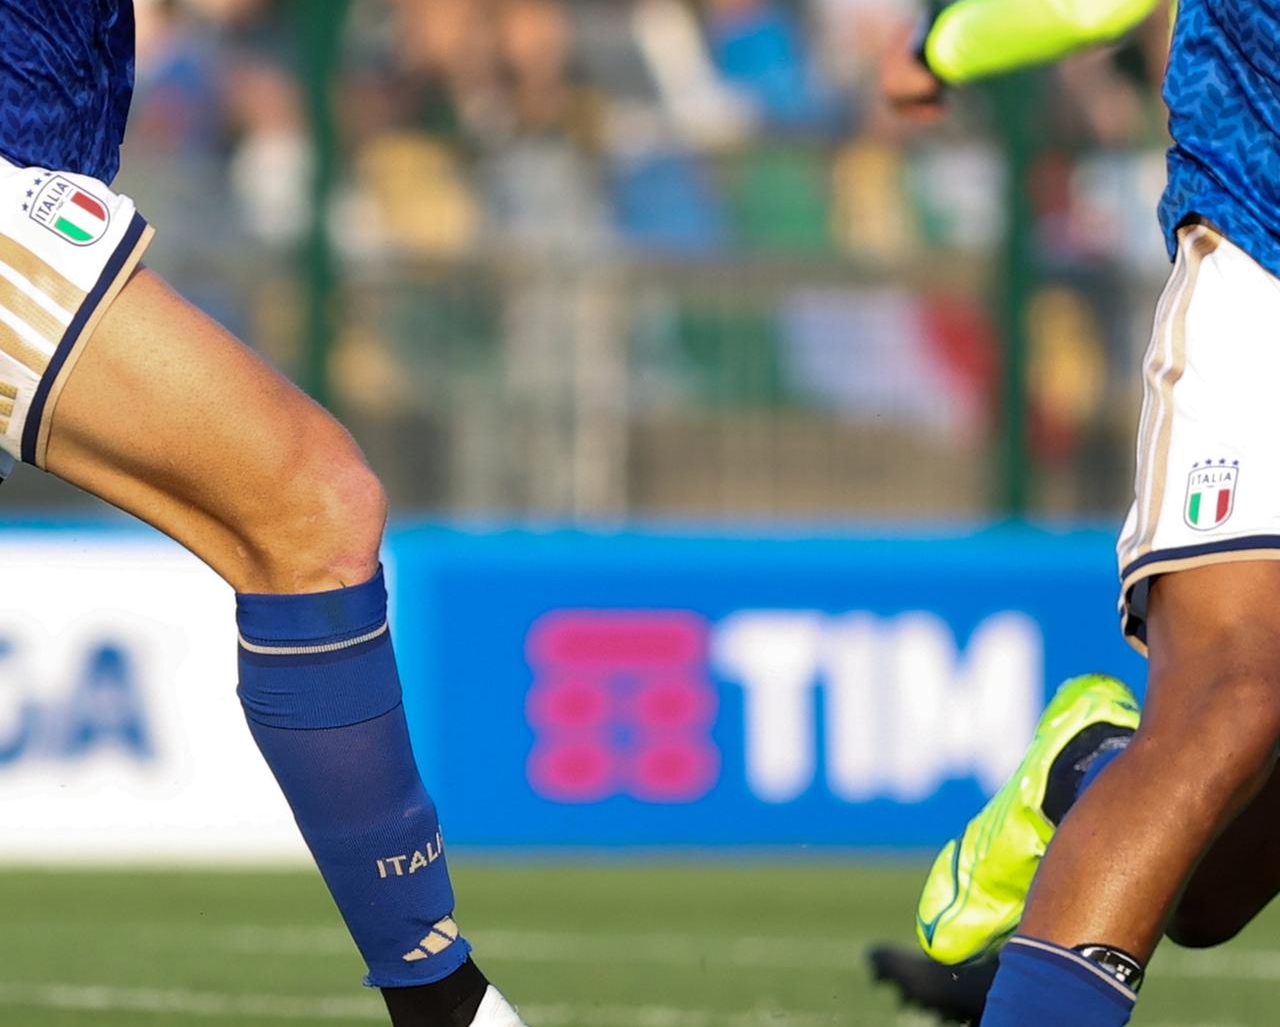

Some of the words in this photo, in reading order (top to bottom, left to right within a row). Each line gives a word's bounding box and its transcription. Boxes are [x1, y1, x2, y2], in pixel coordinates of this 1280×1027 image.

[35, 181, 70, 222] ITALIA
[1191, 471, 1232, 486] ITALIA
[714, 609, 1044, 802] TIM
[376, 831, 444, 879] ITALI
